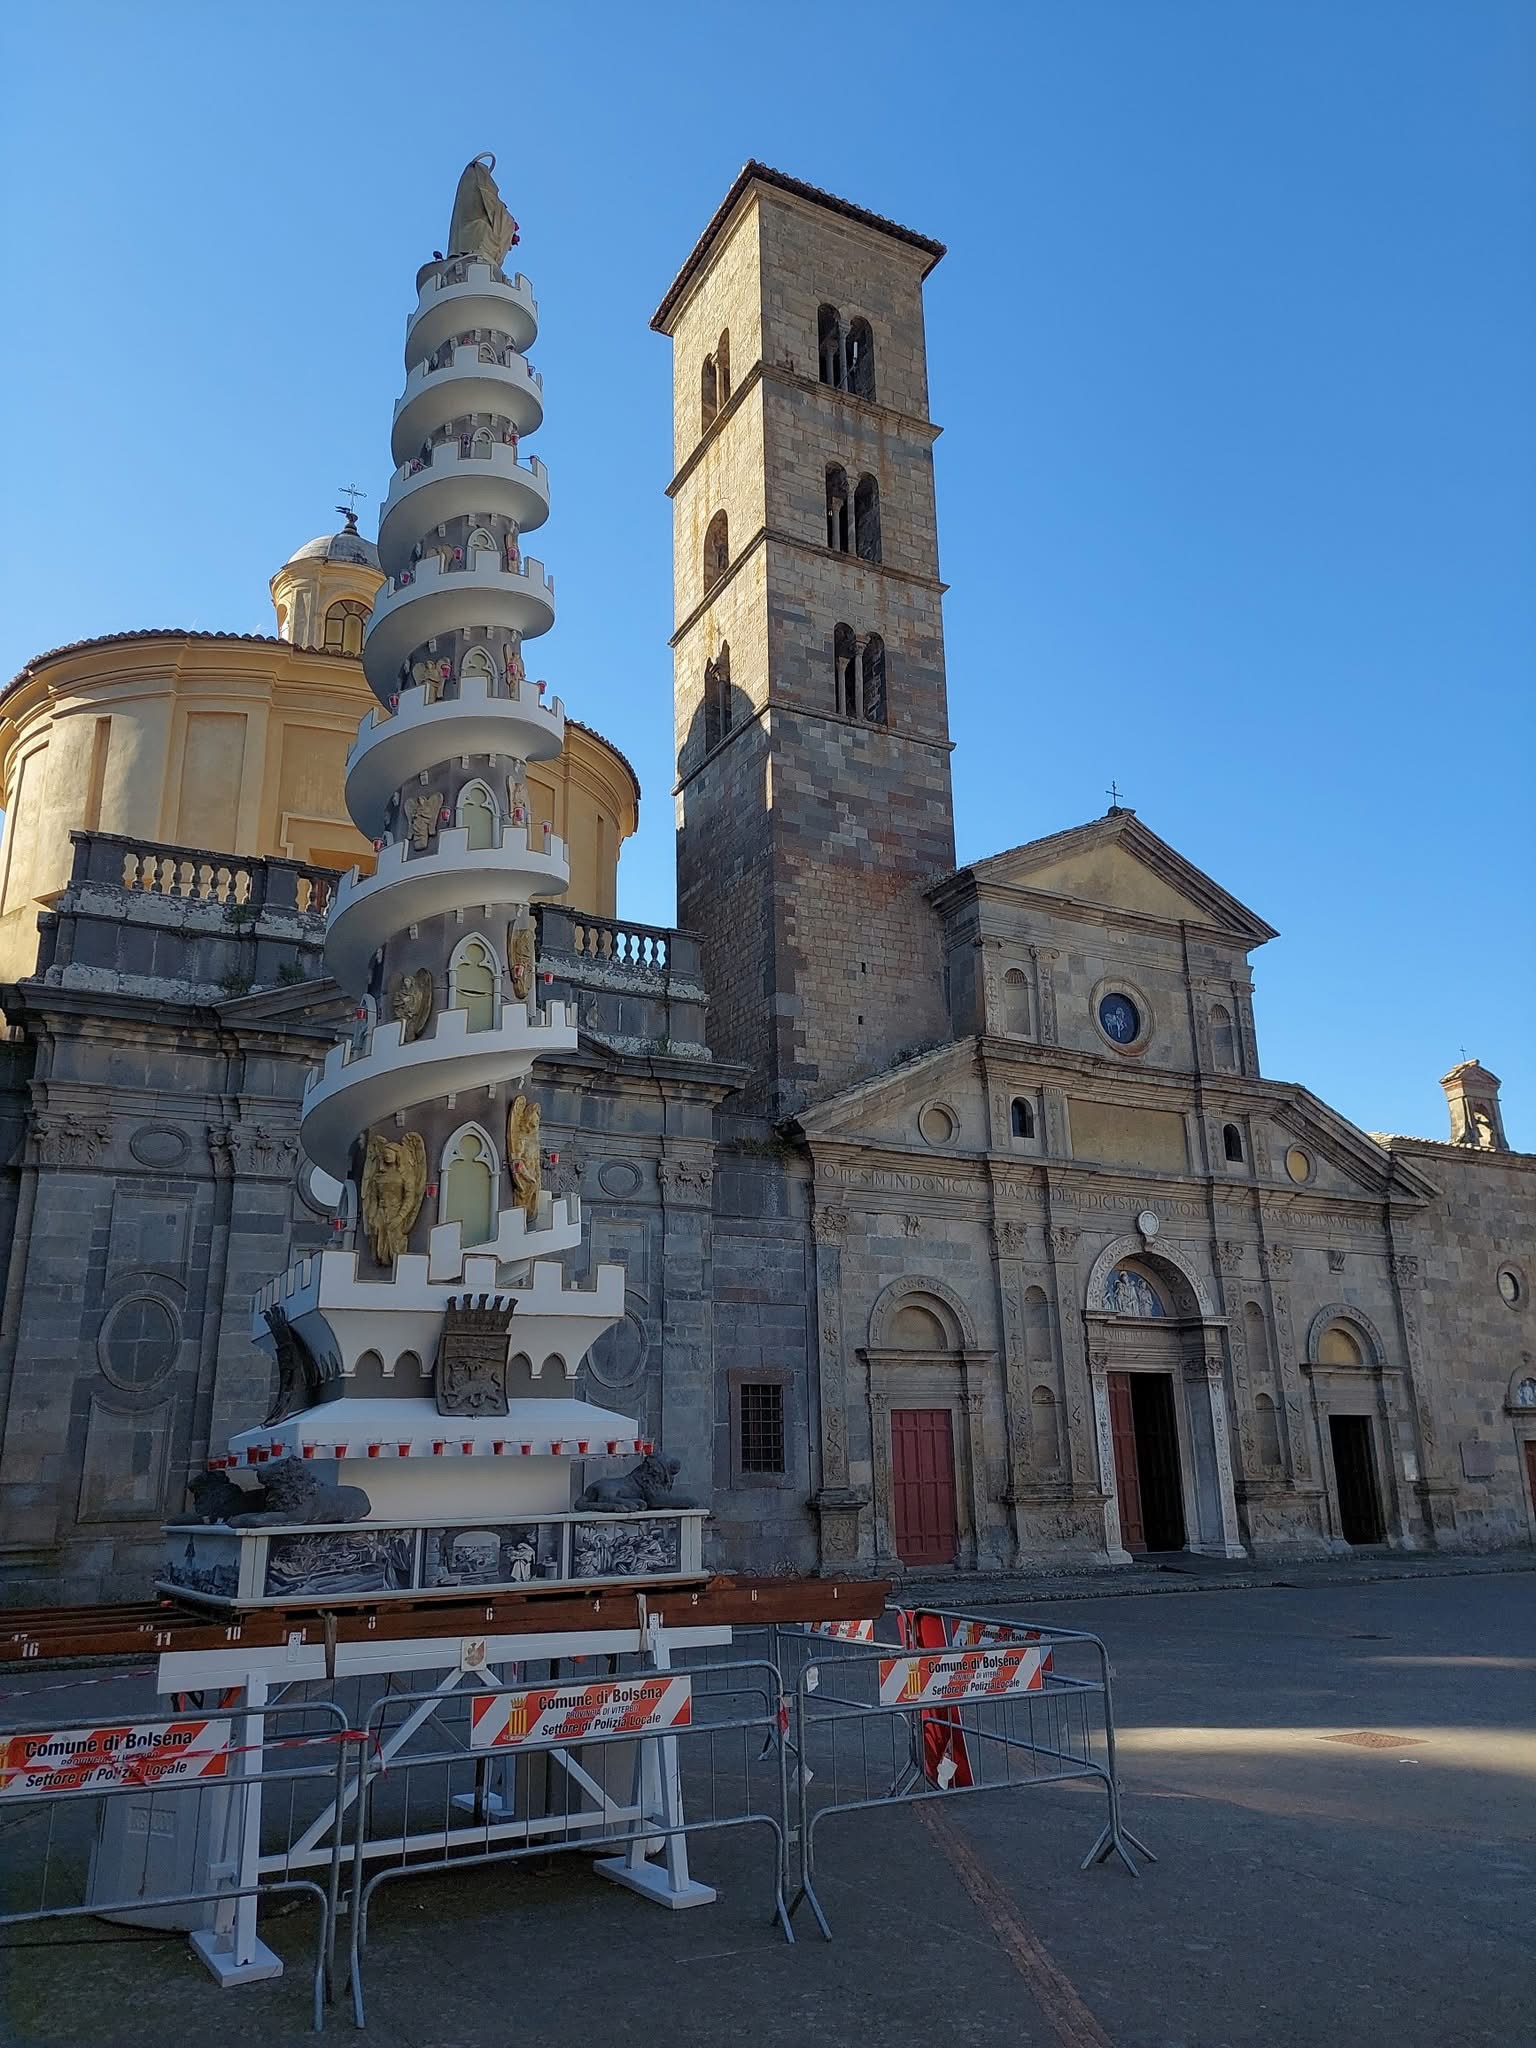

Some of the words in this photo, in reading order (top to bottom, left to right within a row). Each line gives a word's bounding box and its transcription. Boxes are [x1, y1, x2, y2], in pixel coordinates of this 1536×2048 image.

[368, 1615, 377, 1629] 8
[155, 1631, 172, 1646] 11
[928, 1661, 968, 1674] Comune
[971, 1658, 980, 1669] di
[983, 1655, 1020, 1669] Bolsena
[932, 1684, 959, 1696] Settore
[961, 1683, 969, 1692] di
[971, 1680, 994, 1691] Polizia
[997, 1678, 1020, 1689] Locale
[539, 1694, 592, 1710] Comune
[596, 1690, 609, 1704] di
[613, 1687, 662, 1703] Bolsena
[541, 1723, 579, 1736] Settore
[582, 1720, 591, 1731] di
[594, 1717, 627, 1730] Polizia
[630, 1713, 661, 1726] Locale
[25, 1740, 97, 1758] Comune
[103, 1735, 119, 1751] di
[125, 1731, 193, 1750] Bolsena
[25, 1772, 76, 1788] Settore
[80, 1769, 92, 1783] di
[145, 1761, 188, 1777] Locale
